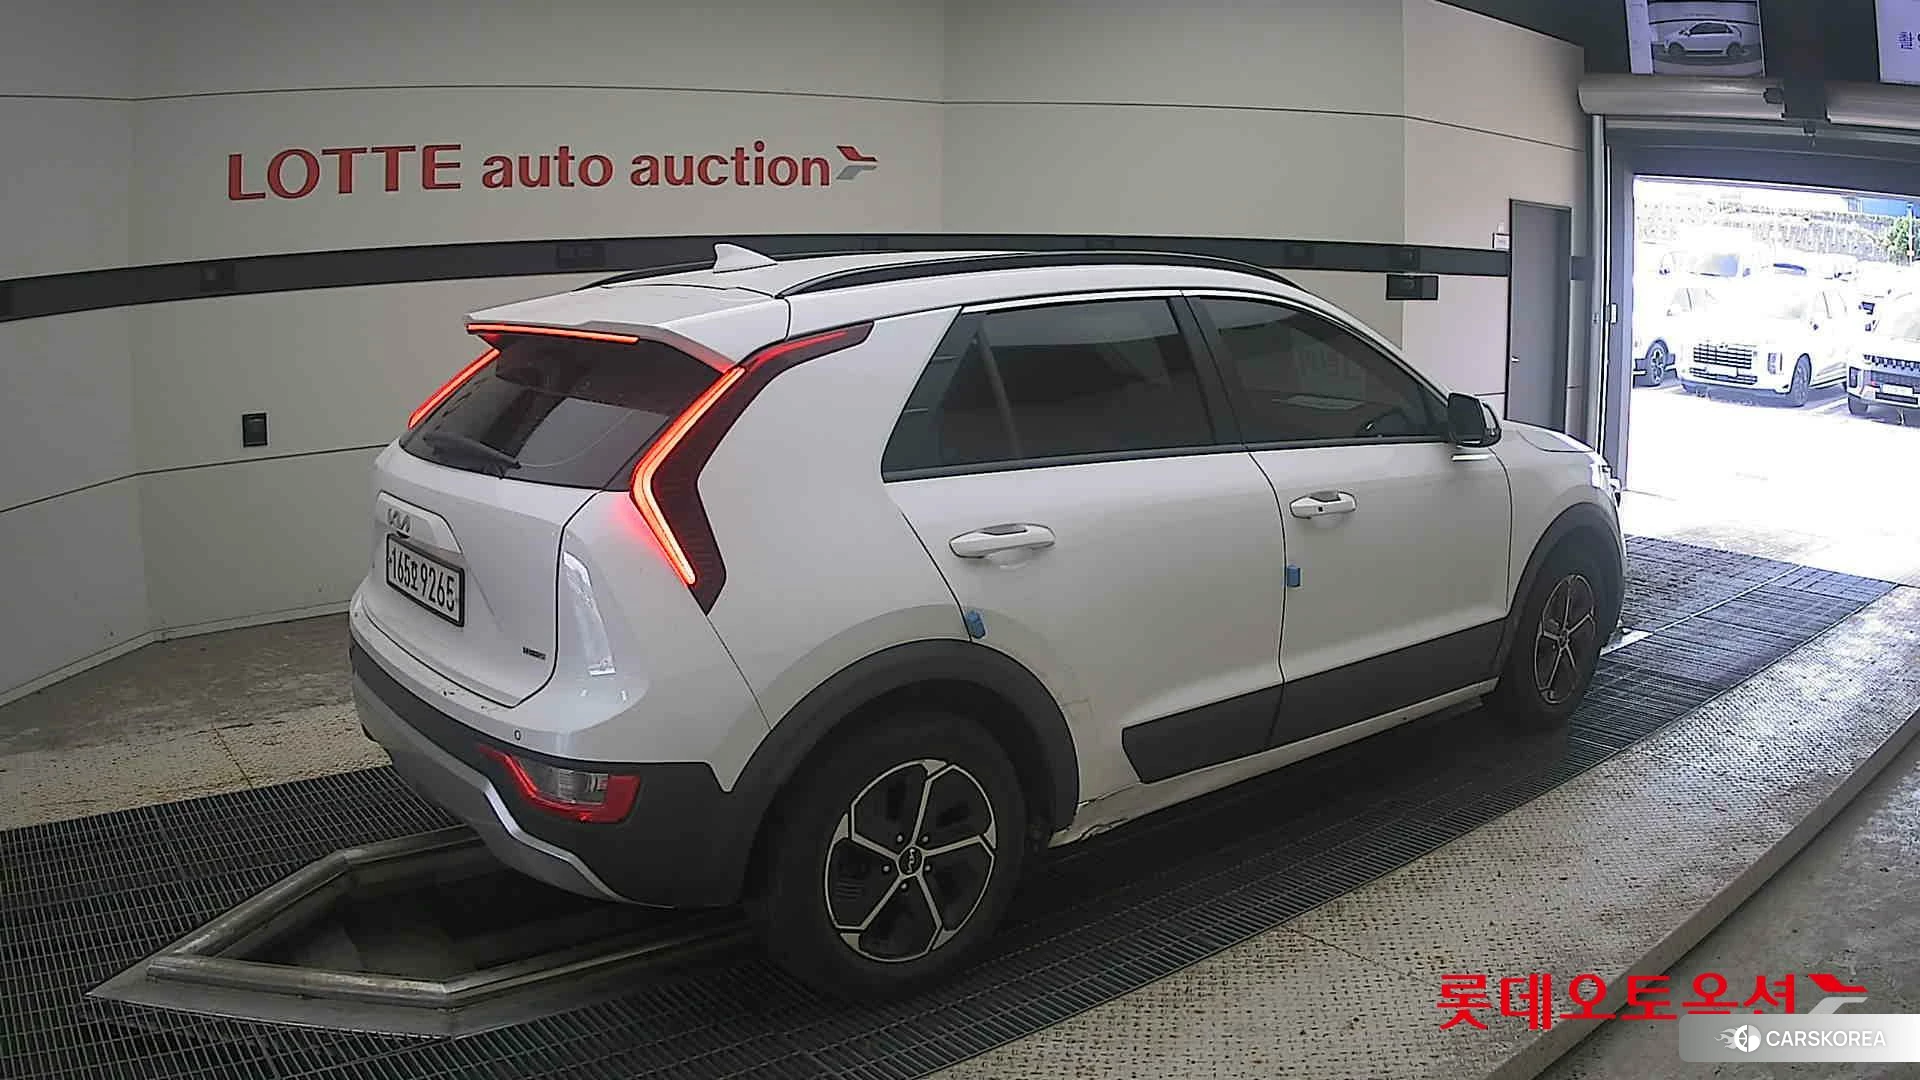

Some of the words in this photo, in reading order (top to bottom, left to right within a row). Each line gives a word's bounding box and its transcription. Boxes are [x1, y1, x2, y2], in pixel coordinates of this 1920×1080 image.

[228, 144, 462, 201] LOTTE
[482, 145, 614, 188] auto
[630, 140, 831, 187] auction
